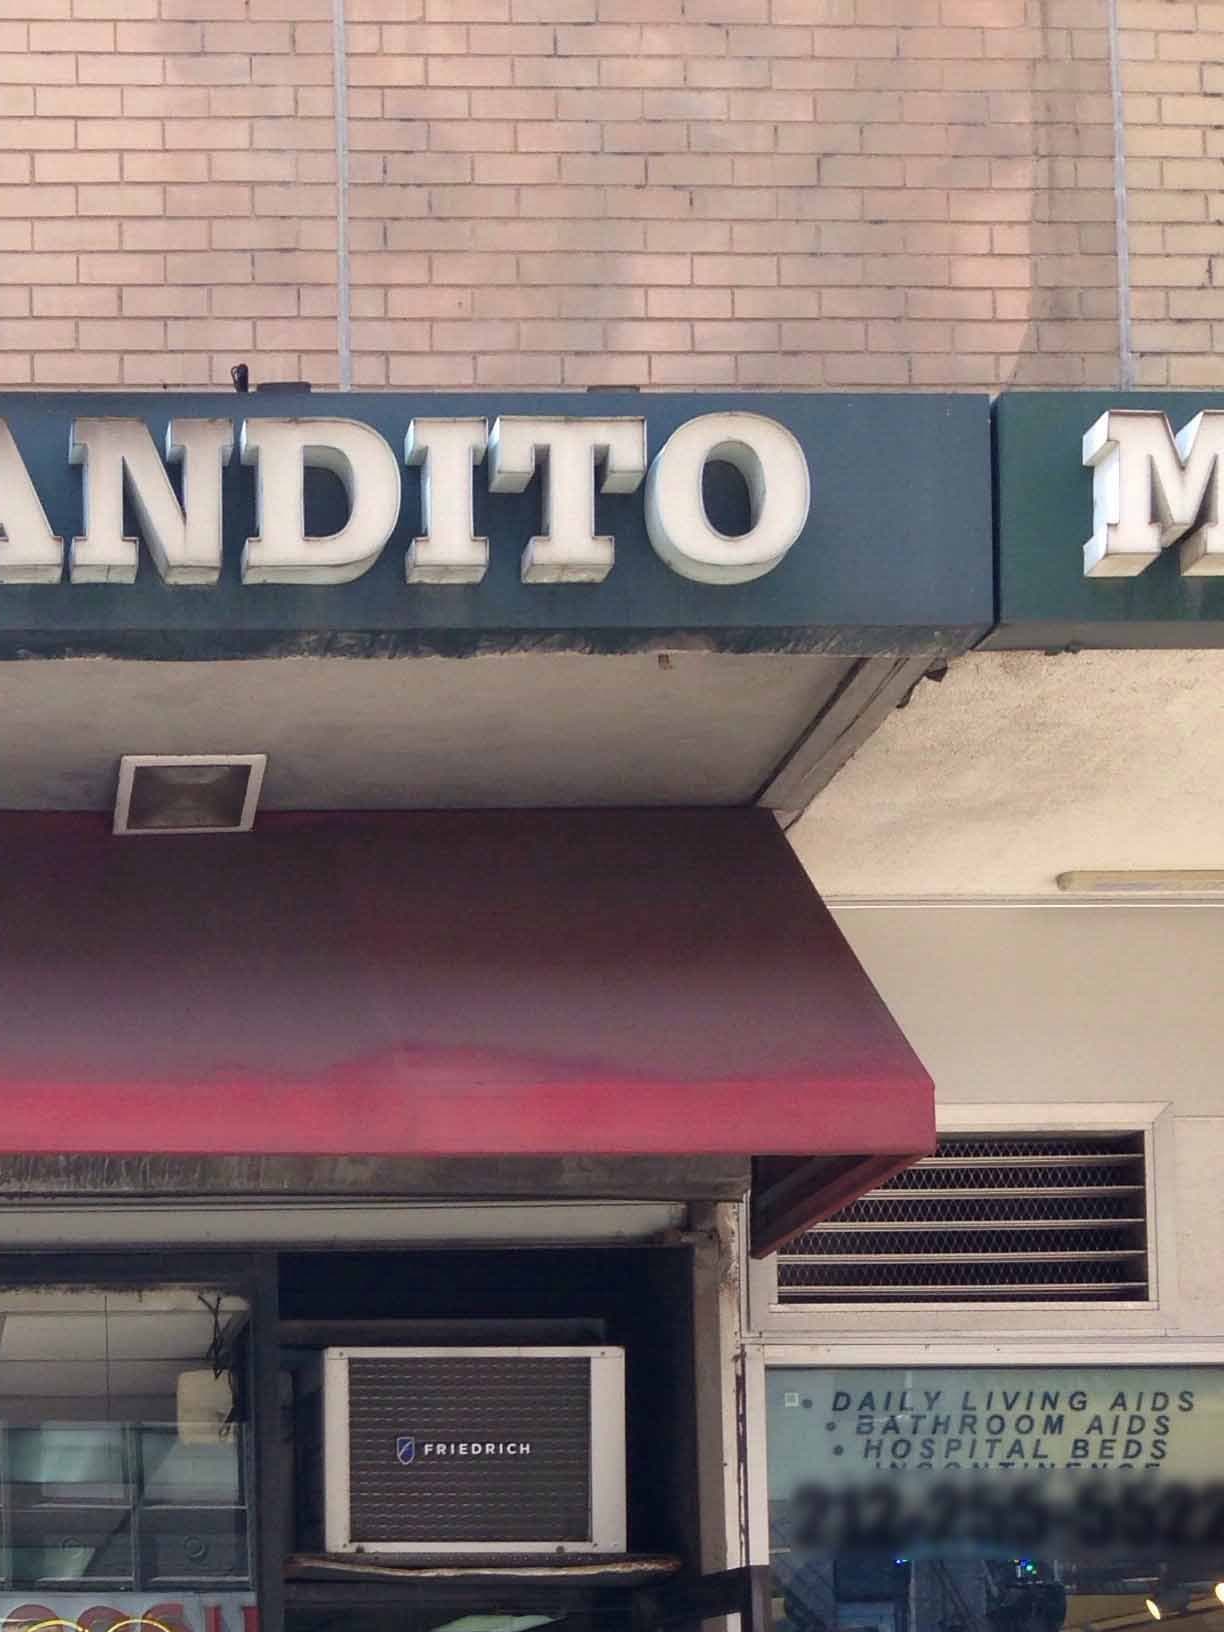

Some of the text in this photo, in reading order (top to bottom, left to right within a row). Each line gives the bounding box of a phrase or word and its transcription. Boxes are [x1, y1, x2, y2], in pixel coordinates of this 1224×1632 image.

[831, 1390, 1196, 1412] DAILY LIVING AIDS
[855, 1414, 1172, 1436] BATHROOM AIDS
[424, 1442, 531, 1456] FRIEDRICH
[862, 1438, 1168, 1460] HOSPITAL BEDS
